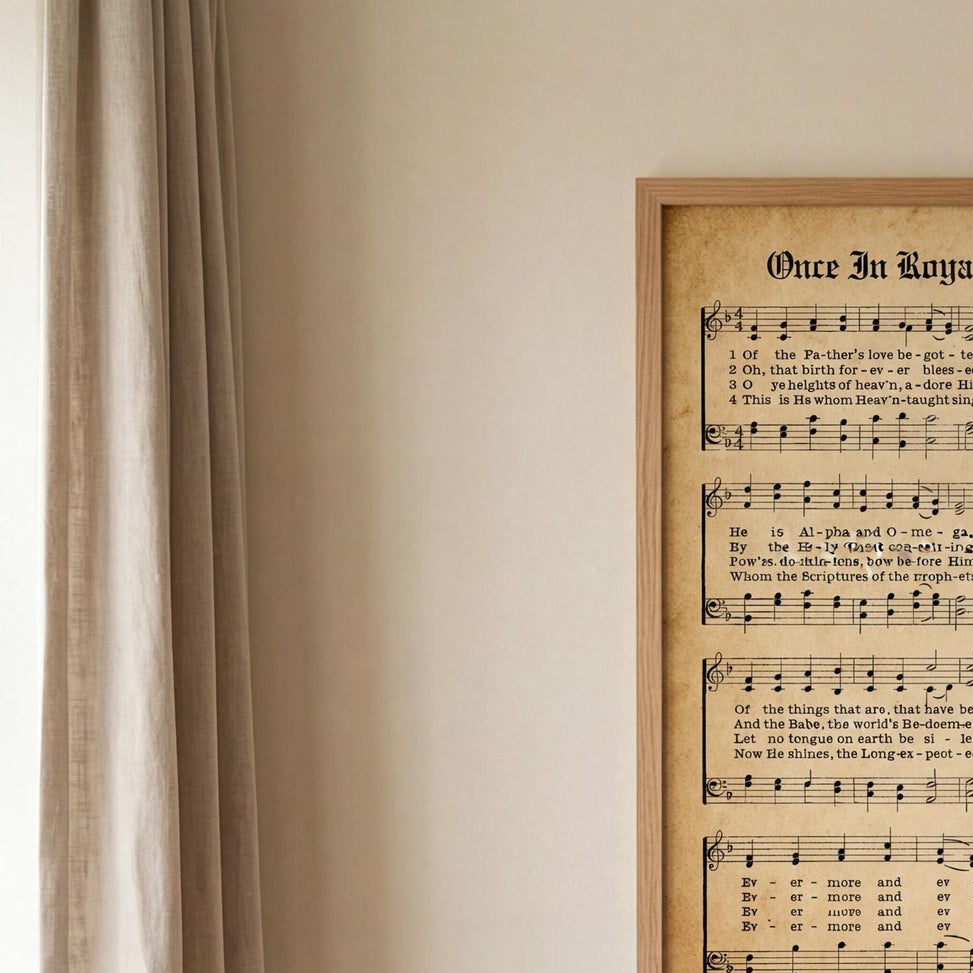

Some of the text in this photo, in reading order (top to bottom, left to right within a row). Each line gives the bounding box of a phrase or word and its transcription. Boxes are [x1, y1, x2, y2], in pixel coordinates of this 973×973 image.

[766, 250, 840, 280] Once
[847, 250, 889, 281] In
[729, 349, 737, 360] 1
[742, 349, 759, 361] Of
[774, 349, 797, 361] the
[868, 349, 894, 360] love
[728, 364, 737, 375] 2
[742, 364, 766, 377] Oh,
[769, 363, 799, 376] that
[800, 364, 836, 376] birth
[728, 379, 737, 390] 3
[742, 379, 754, 390] O
[770, 381, 786, 393] ye
[837, 379, 853, 391] of
[728, 394, 737, 405] 4
[741, 393, 772, 406] This
[778, 393, 790, 406] is
[813, 394, 854, 406] whom
[729, 526, 748, 538] He
[770, 526, 784, 538] is
[729, 541, 748, 555] By
[729, 570, 773, 582] Whom
[775, 570, 798, 582] the
[801, 570, 869, 583] Scriptures
[871, 570, 886, 582] of
[888, 570, 910, 582] the
[734, 704, 751, 715] Of
[761, 703, 785, 715] the
[787, 703, 830, 718] things
[833, 703, 862, 715] that
[893, 703, 921, 715] that
[924, 703, 954, 715] have
[733, 718, 761, 730] And
[763, 718, 786, 730] the
[733, 733, 757, 744] Let
[767, 735, 785, 744] no
[788, 733, 834, 747] tongue
[836, 735, 854, 745] on
[857, 732, 893, 745] earth
[898, 732, 915, 744] be
[733, 748, 763, 759] Now
[835, 747, 858, 759] the
[826, 879, 862, 888] more
[877, 877, 902, 888] and
[936, 878, 951, 888] ev
[827, 893, 862, 903] more
[877, 891, 903, 902] and
[936, 893, 951, 902] ev
[790, 908, 804, 917] er
[877, 905, 903, 917] and
[936, 908, 951, 917] ev
[827, 923, 862, 932] more
[877, 920, 903, 932] and
[936, 922, 951, 931] ev
